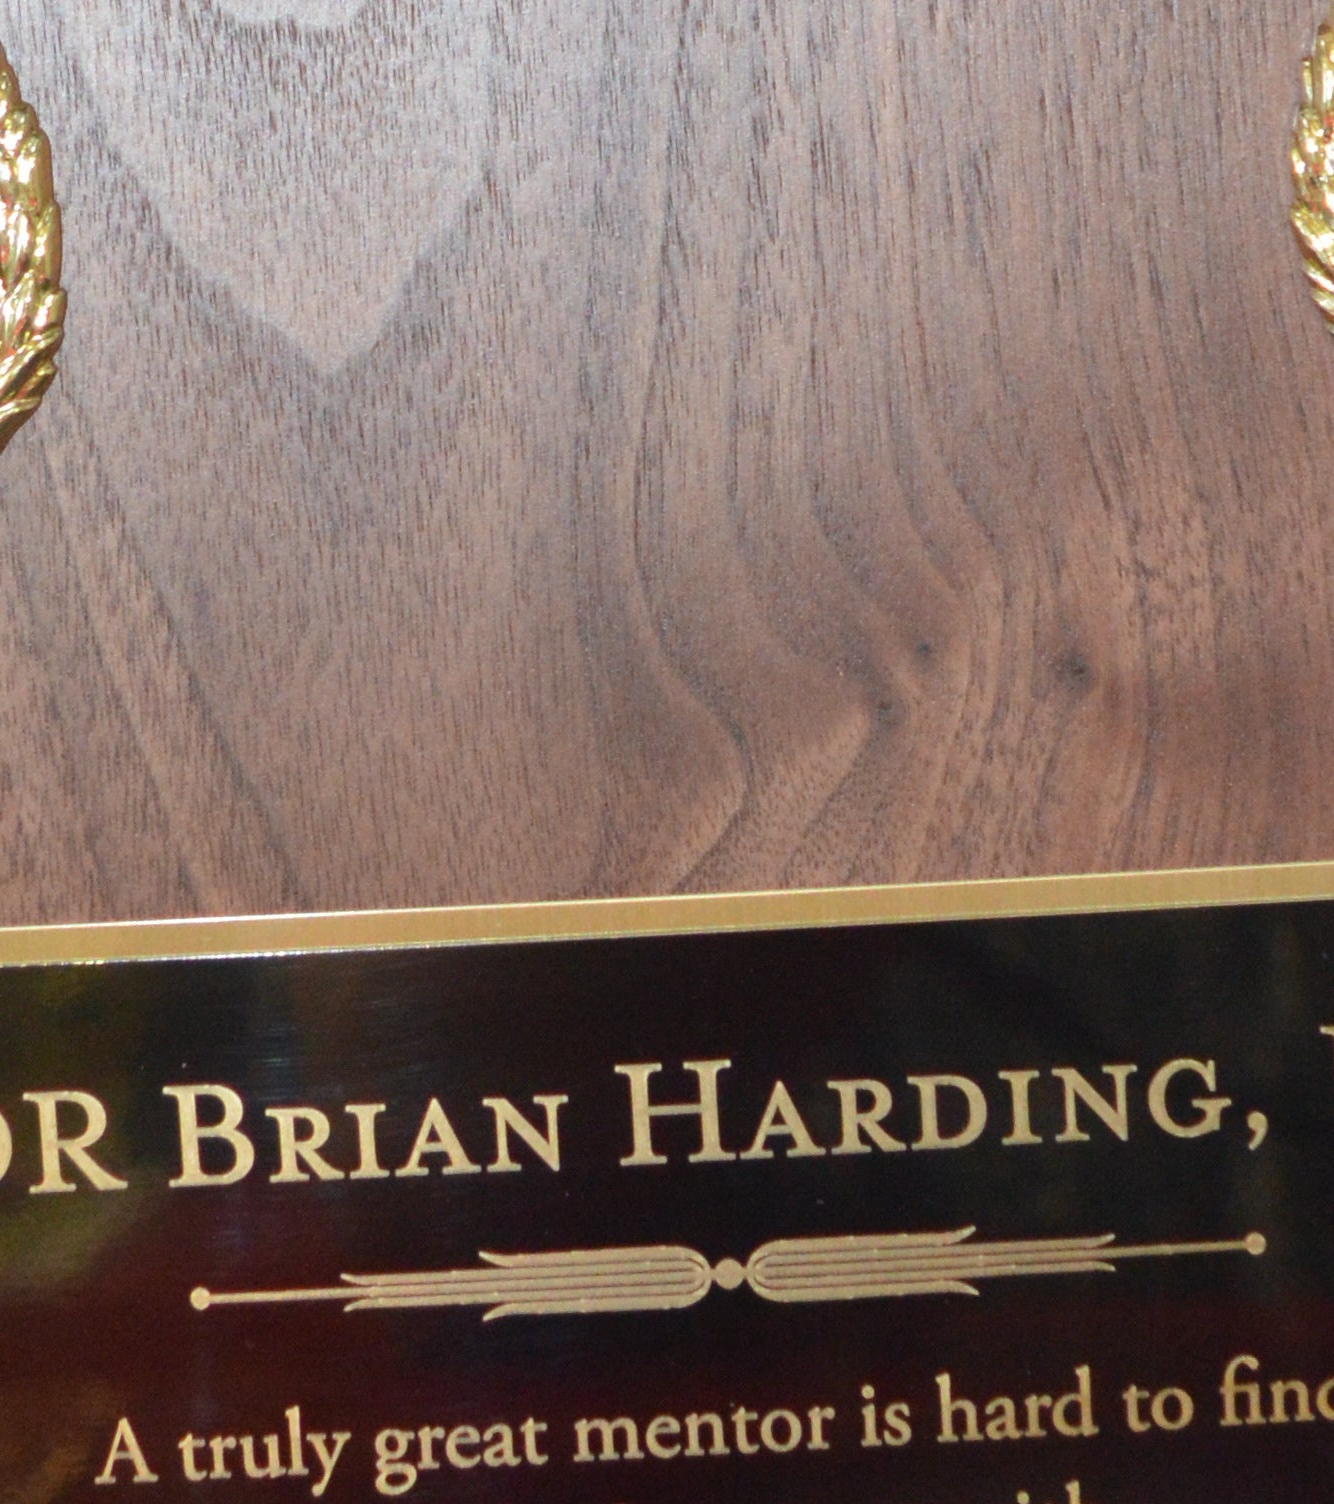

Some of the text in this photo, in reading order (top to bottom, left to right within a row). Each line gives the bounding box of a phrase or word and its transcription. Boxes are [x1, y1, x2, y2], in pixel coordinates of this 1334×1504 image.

[94, 1416, 159, 1486] A
[177, 1404, 352, 1498] truly
[373, 1416, 549, 1497] great
[572, 1405, 836, 1463] mentor
[860, 1383, 912, 1448] is
[934, 1364, 1100, 1443] hard
[1122, 1383, 1195, 1433] to
